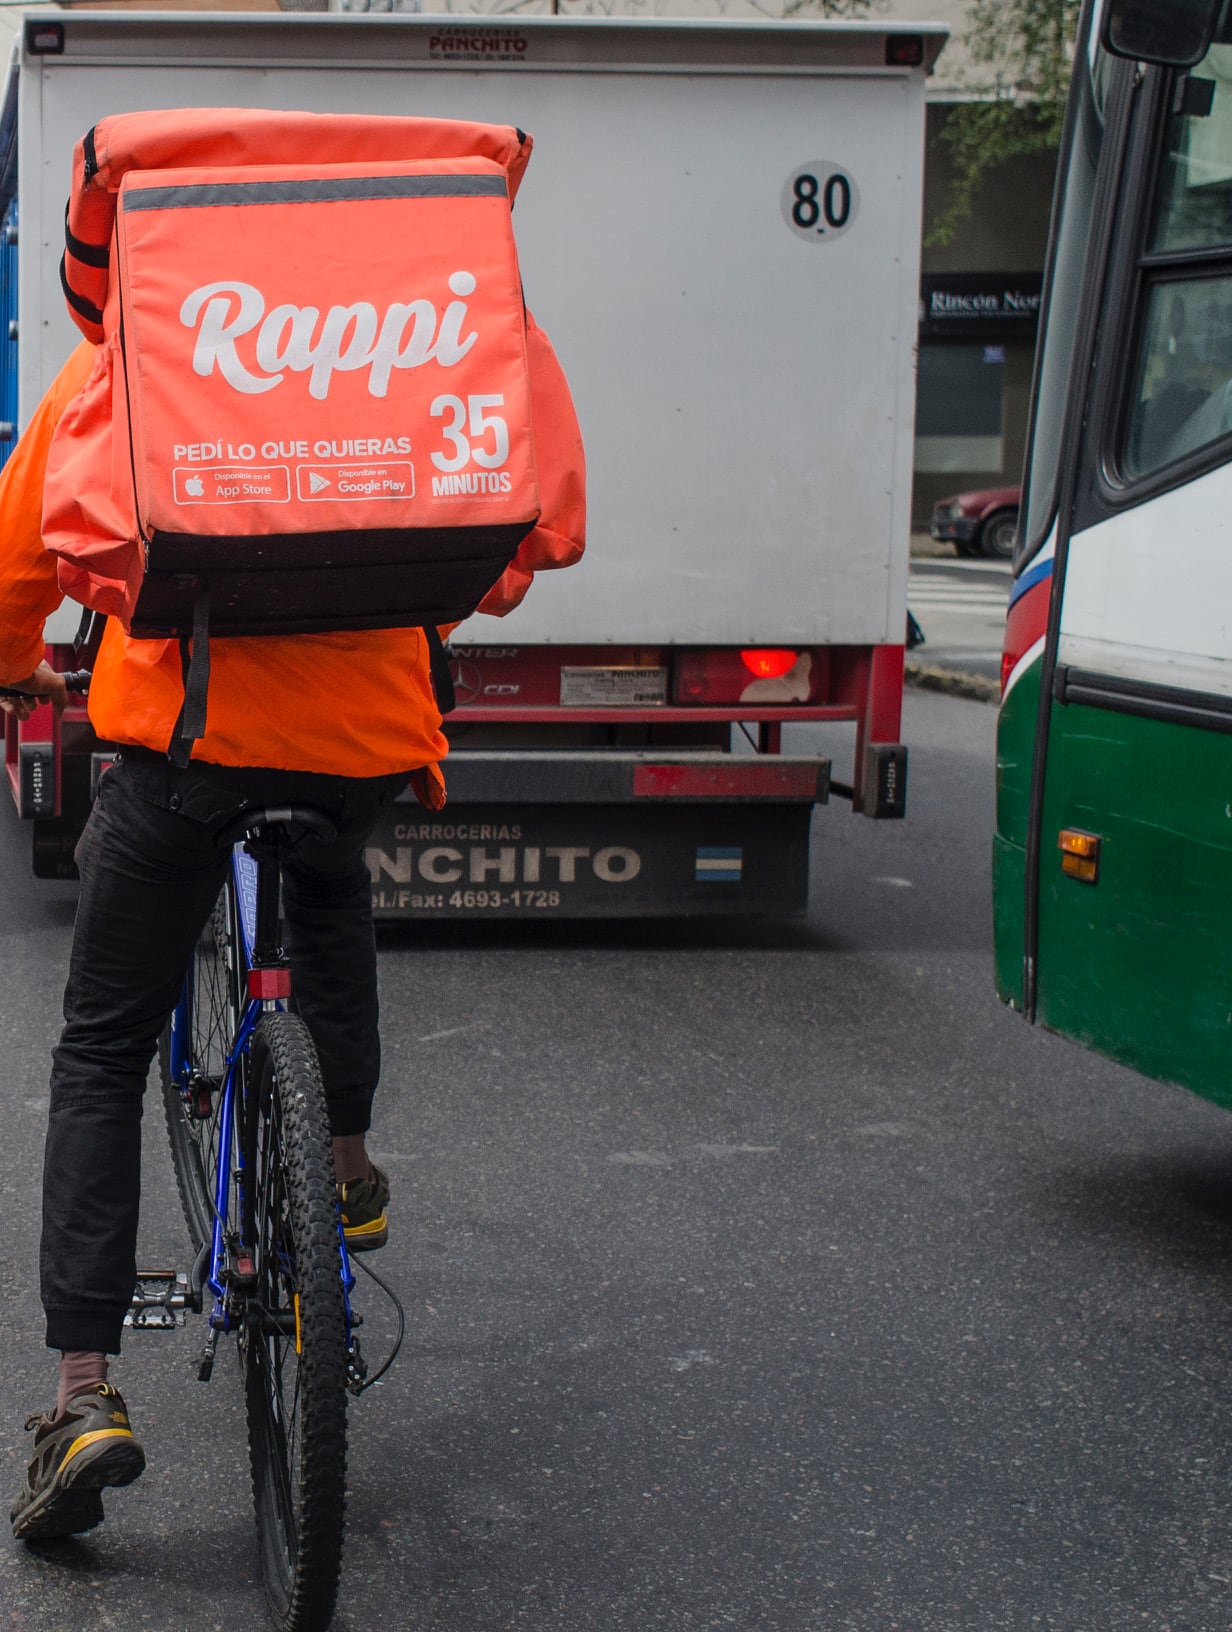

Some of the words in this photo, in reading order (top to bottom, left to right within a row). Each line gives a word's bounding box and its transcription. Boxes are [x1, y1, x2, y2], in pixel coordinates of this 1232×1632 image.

[429, 36, 528, 52] PANCHITO
[792, 173, 850, 228] 80
[179, 270, 478, 400] Rappi
[430, 393, 509, 473] 35
[173, 439, 222, 462] PEDÍ
[228, 443, 256, 460] LO
[261, 440, 309, 459] QUE
[313, 437, 411, 458] QUIERAS
[214, 472, 253, 482] Disponible
[338, 468, 376, 478] Disponible
[215, 483, 240, 497] App
[242, 483, 272, 495] Store
[338, 479, 381, 494] Google
[382, 478, 406, 493] Play
[431, 471, 512, 497] MINUTOS
[394, 824, 521, 840] CARROCERIAS
[449, 889, 560, 908] 4693-1728
